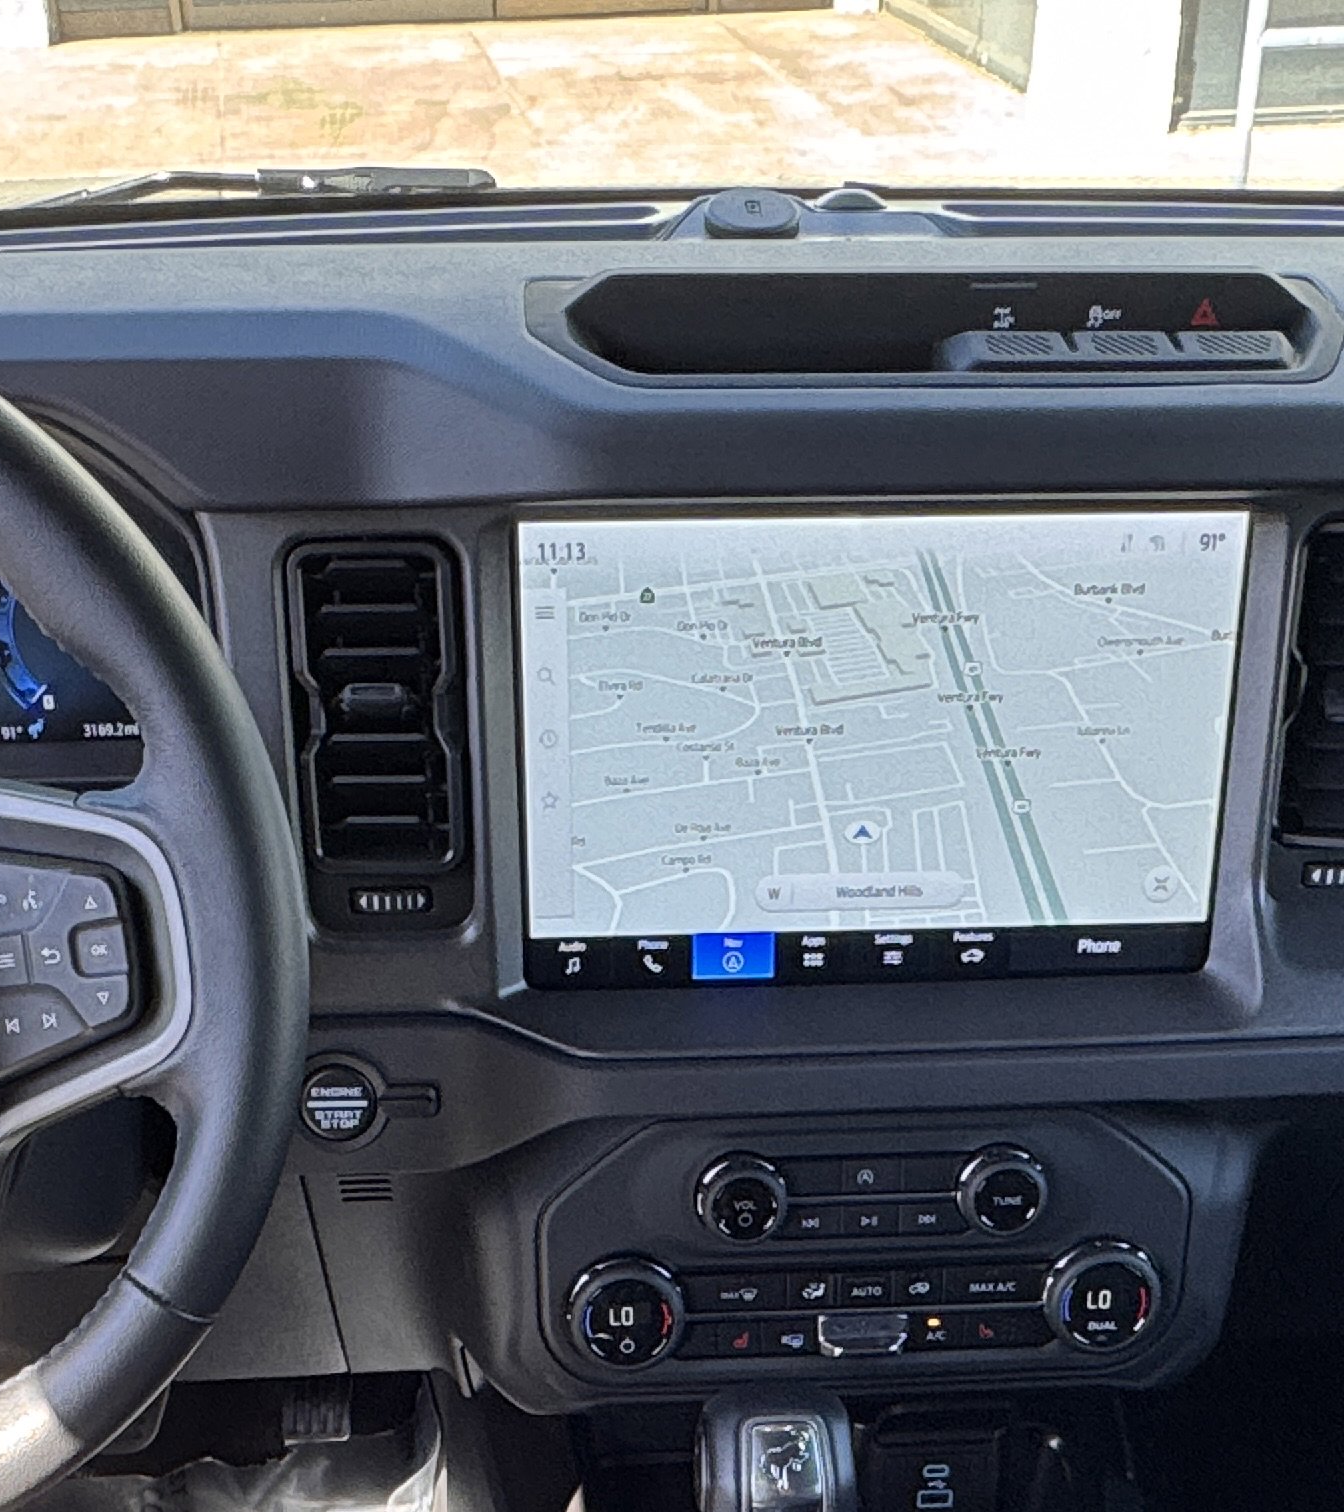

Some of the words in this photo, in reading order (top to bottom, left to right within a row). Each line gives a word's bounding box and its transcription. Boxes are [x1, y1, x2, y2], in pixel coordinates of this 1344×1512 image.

[1199, 533, 1226, 551] 91°
[538, 542, 586, 561] 11:13
[752, 636, 795, 648] Ventura
[836, 885, 896, 898] Woodland
[1077, 940, 1122, 954] Phone
[310, 1086, 363, 1098] ENGINE
[314, 1110, 363, 1121] START
[320, 1120, 360, 1131] STOP
[734, 1200, 757, 1211] VOL
[850, 1286, 882, 1297] AUTO
[968, 1281, 994, 1293] MAX
[996, 1281, 1017, 1293] A/C
[1087, 1320, 1118, 1332] DUAL
[926, 1330, 947, 1342] A/C
